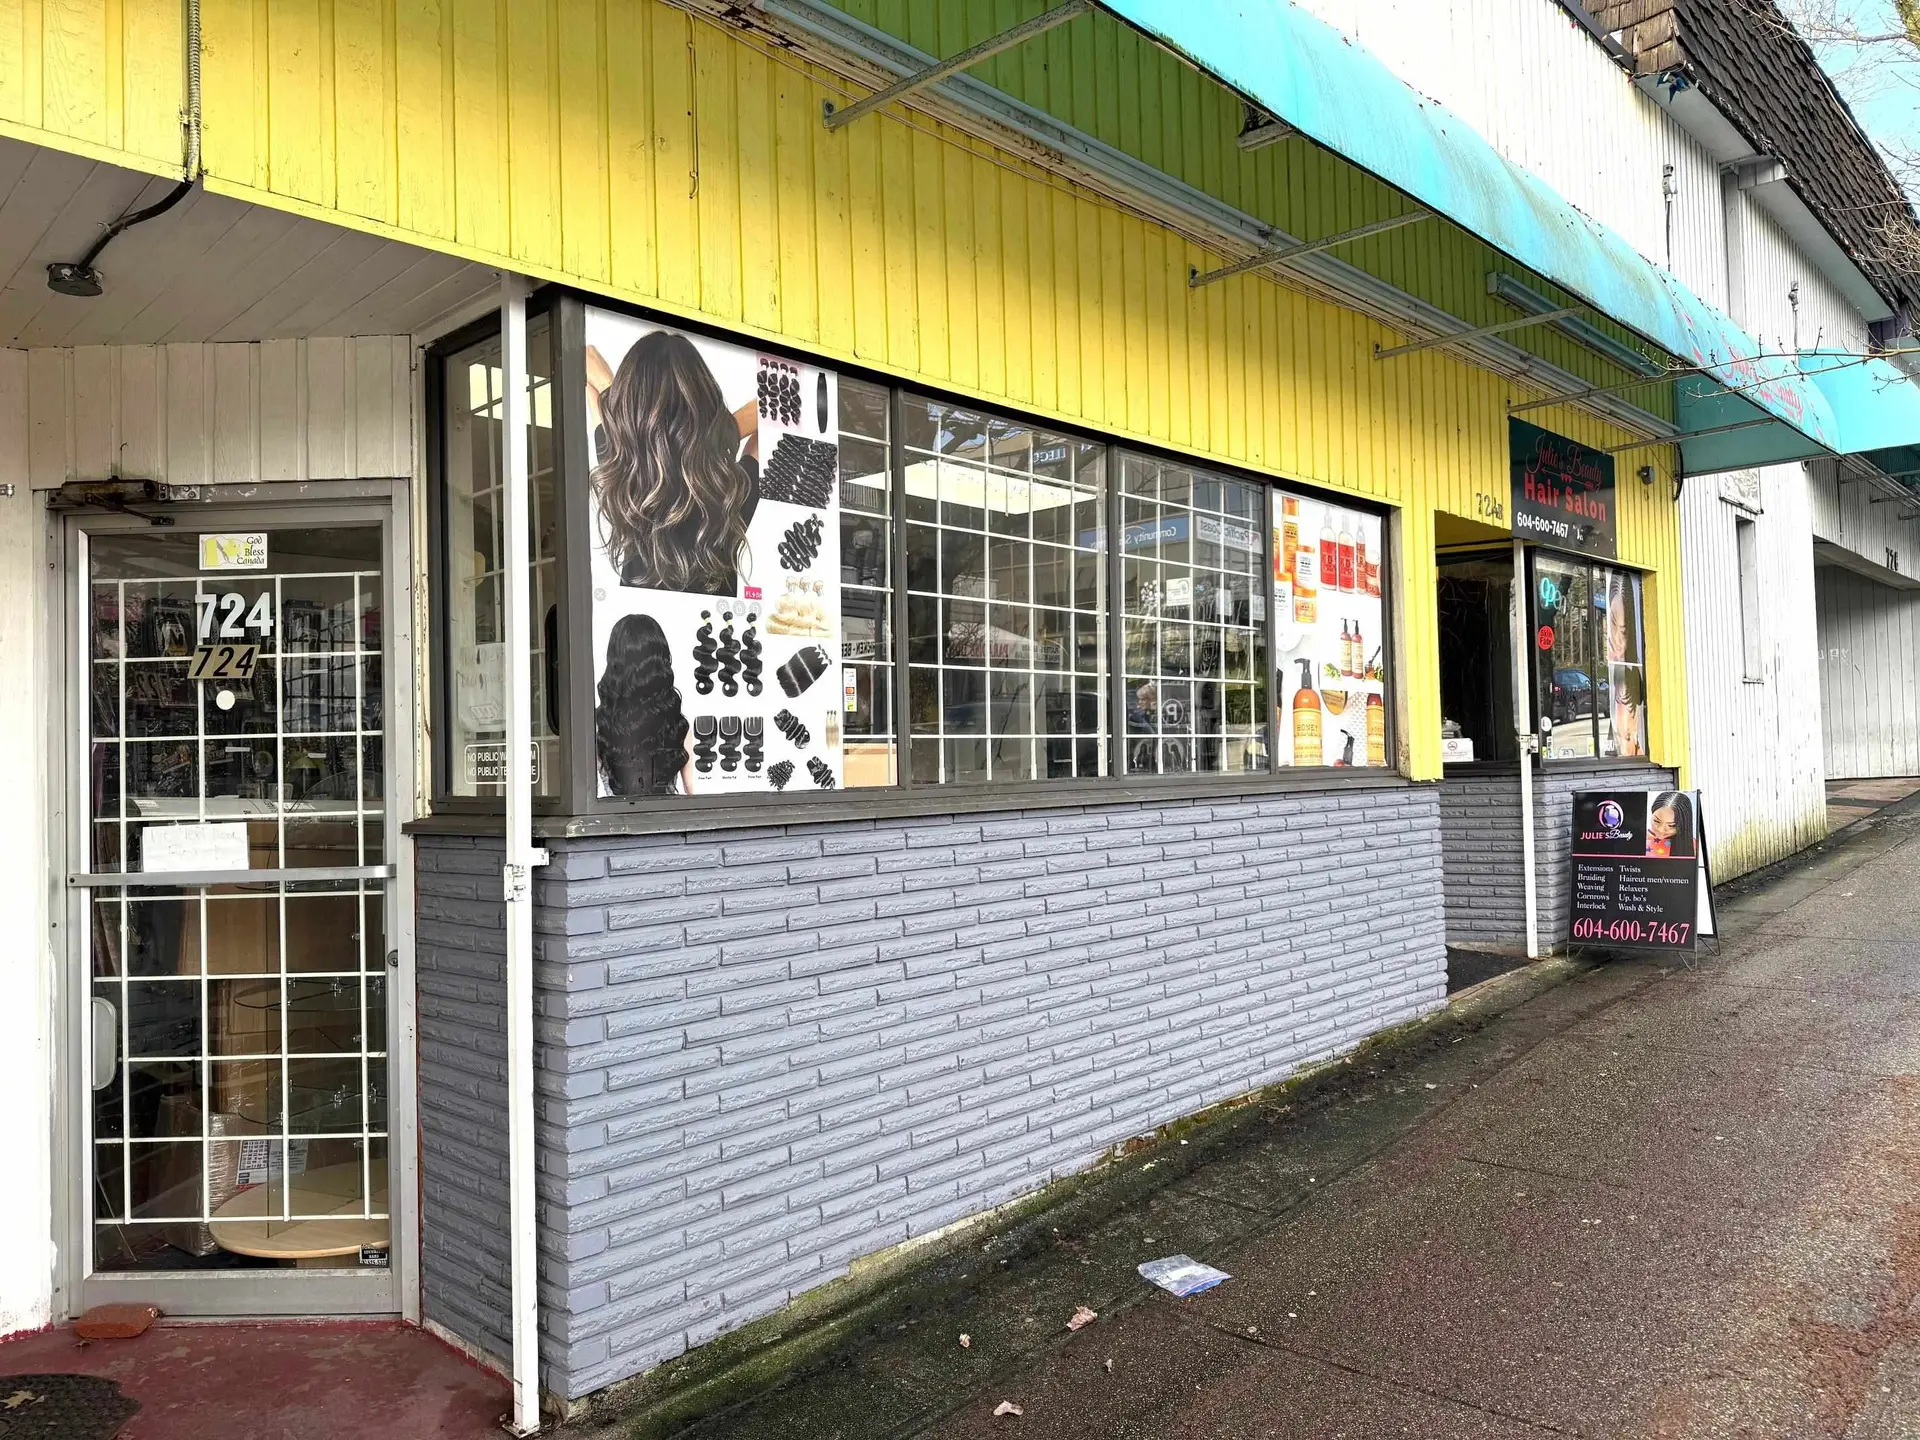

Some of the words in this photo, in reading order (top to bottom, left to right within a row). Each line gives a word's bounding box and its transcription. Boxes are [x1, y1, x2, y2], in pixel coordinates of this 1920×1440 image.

[1524, 472, 1560, 508] Hair
[1565, 486, 1607, 522] Salon
[1516, 511, 1569, 539] 604-600-7467
[246, 535, 263, 545] God
[244, 544, 265, 557] Bless
[236, 555, 265, 565] Canada
[195, 592, 274, 638] 724
[1540, 629, 1553, 637] Skin
[1540, 637, 1552, 646] Fade
[194, 646, 256, 677] 724
[467, 751, 476, 762] NO
[477, 751, 499, 762] PUBLIC
[467, 765, 476, 776] NO
[477, 765, 499, 776] PUBLIC
[1580, 831, 1610, 840] JULIE'S
[1609, 829, 1633, 841] Beauty
[1578, 864, 1614, 872] Extensions
[1619, 865, 1641, 873] Twists
[1577, 873, 1606, 882] Braiding
[1619, 875, 1646, 883] Haircut
[1646, 877, 1689, 885] men/women
[1577, 882, 1605, 892] Weaving
[1619, 885, 1649, 893] Relaxers
[1576, 892, 1610, 901] Cornrows
[1576, 902, 1607, 910] Interlock
[1618, 903, 1637, 911] Wash
[1637, 904, 1645, 912] &
[1645, 904, 1664, 914] Style
[1573, 917, 1690, 944] 604-600-7467
